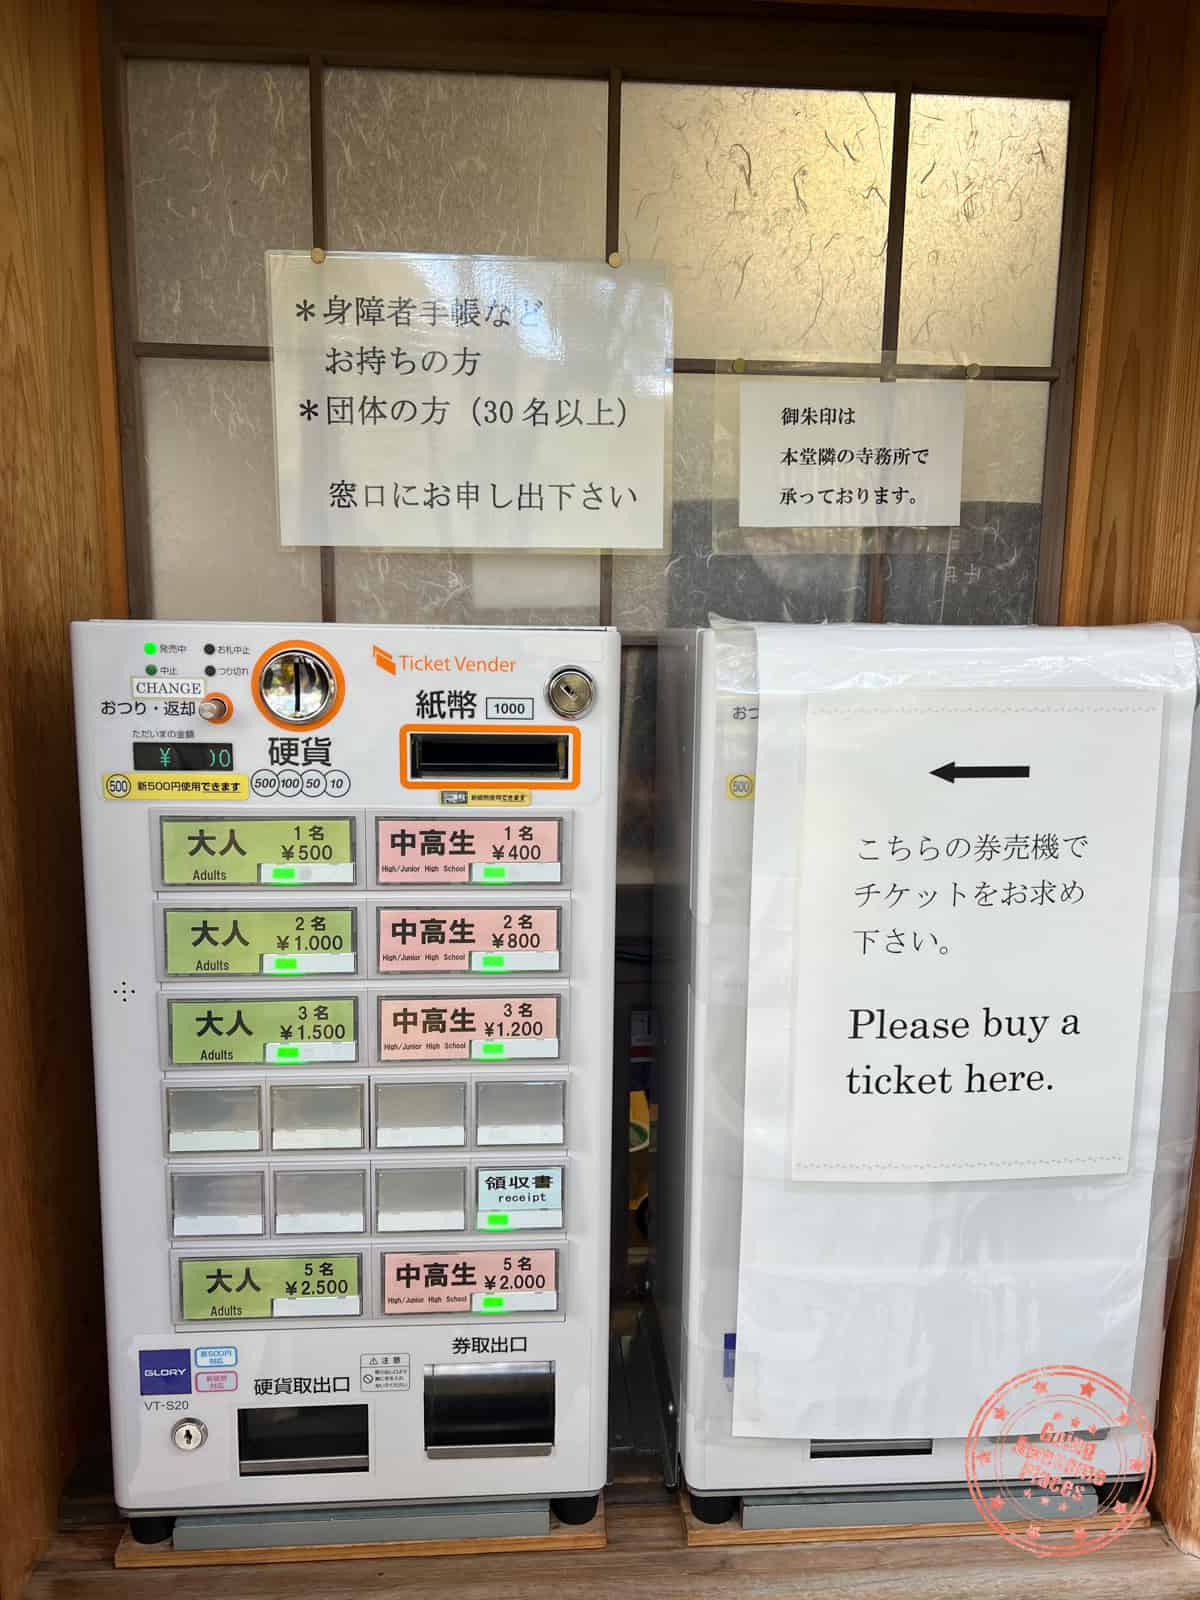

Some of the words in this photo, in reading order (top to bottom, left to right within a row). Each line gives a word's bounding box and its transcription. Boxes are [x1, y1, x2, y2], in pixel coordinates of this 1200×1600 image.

[325, 346, 481, 376] お持ちの方
[781, 407, 856, 426] 御朱印は
[780, 447, 929, 466] 本堂隣の寺務所で
[329, 480, 638, 511] 窓口にお申し出下さい
[779, 487, 918, 505] 承っております。
[399, 655, 450, 672] Ticket
[454, 656, 517, 673] Vender
[136, 682, 202, 695] CHANGE
[101, 700, 196, 717] おつり・返却
[416, 690, 477, 720] 紙幣
[494, 702, 526, 715] 1000
[268, 737, 332, 767] 硬貨
[109, 779, 128, 793] 500
[254, 777, 276, 790] 500
[281, 777, 300, 790] 100
[306, 777, 320, 790] 50
[330, 777, 344, 790] 10
[187, 829, 248, 857] 大人
[390, 829, 476, 857] 中高生
[857, 833, 1090, 862] こちらの券売機で
[192, 869, 227, 881] Adults
[854, 880, 1085, 909] チケットをお求め
[191, 920, 250, 947] 大人
[391, 918, 476, 945] 中高生
[854, 927, 952, 957] 下さい。
[195, 959, 230, 972] Adults
[195, 1010, 254, 1037] 大人
[392, 1007, 477, 1034] 中高生
[848, 1007, 970, 1040] Please
[983, 1008, 1051, 1044] buy
[1061, 1014, 1081, 1036] a
[200, 1049, 234, 1061] Adults
[847, 1064, 953, 1096] ticket
[965, 1062, 1054, 1094] here.
[498, 1193, 547, 1203] receipt
[206, 1268, 261, 1294] 大人
[396, 1262, 477, 1289] 中高生
[210, 1305, 243, 1317] Adults
[451, 1336, 528, 1355] 券取出口
[144, 1368, 186, 1377] GLORY
[253, 1376, 350, 1395] 硬貨取出口
[144, 1401, 189, 1411] VT-S20
